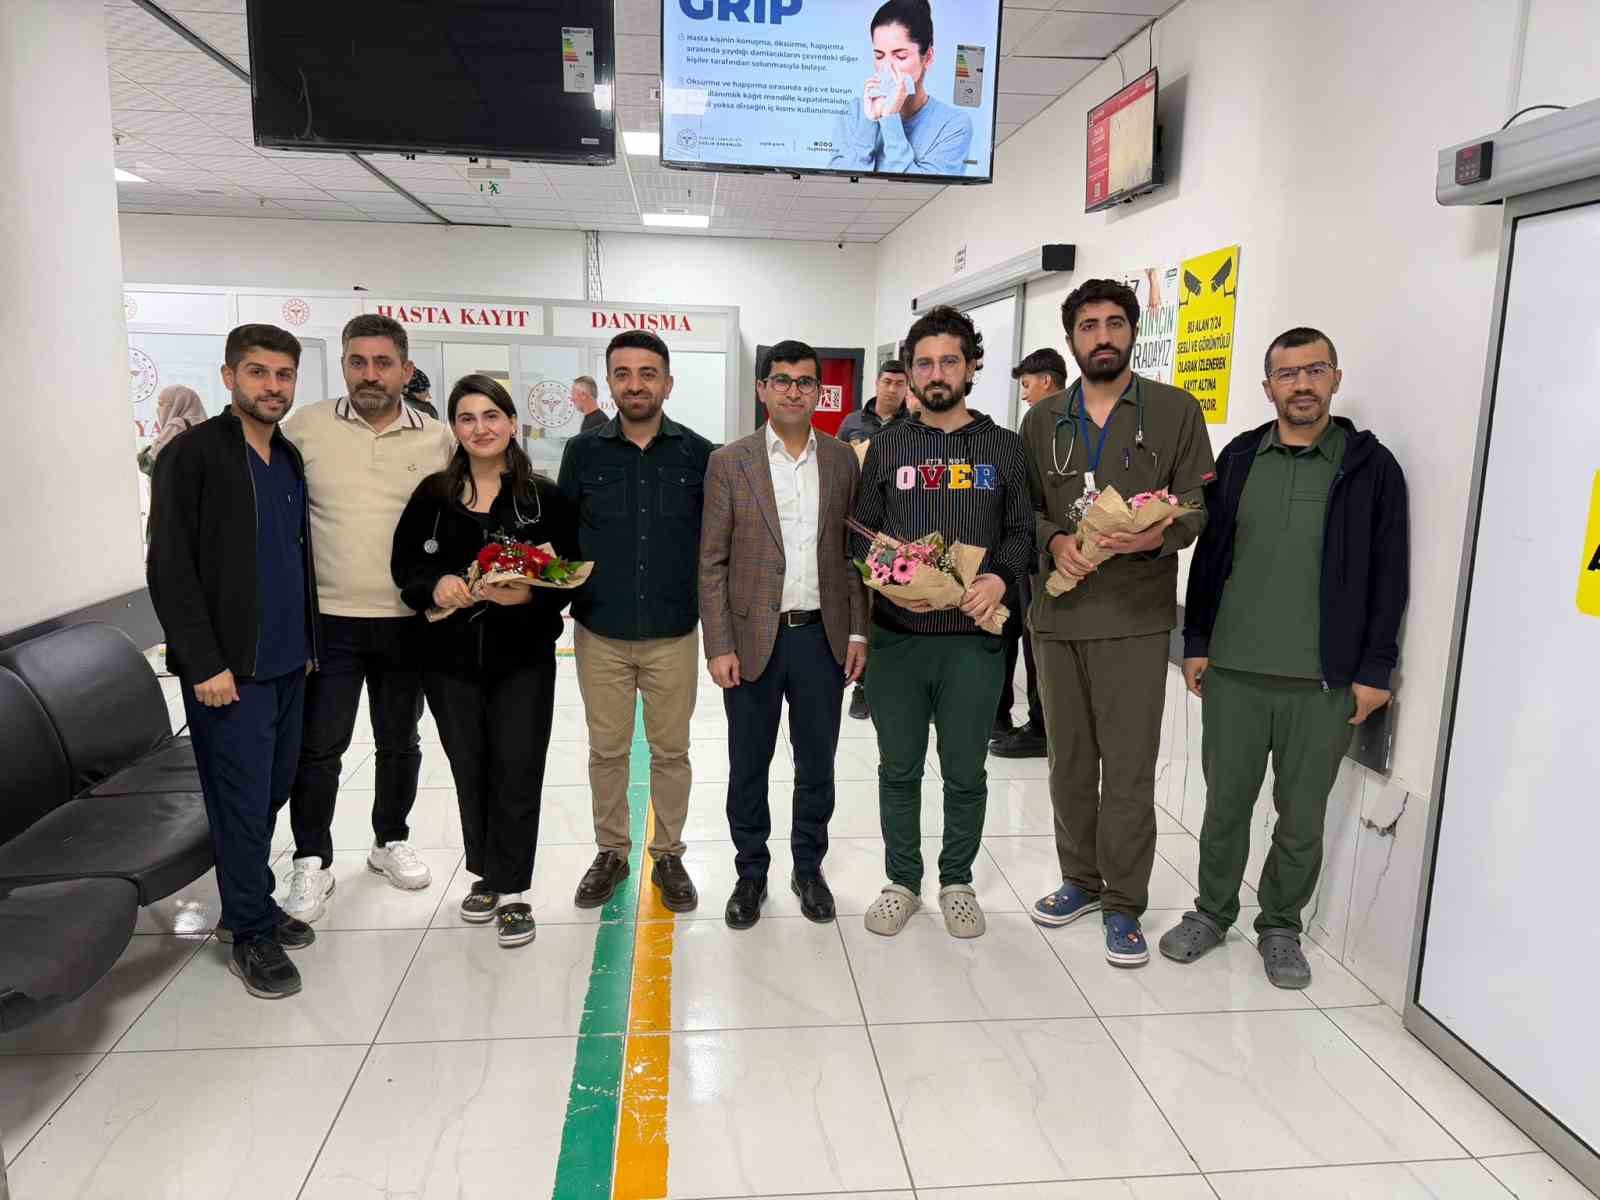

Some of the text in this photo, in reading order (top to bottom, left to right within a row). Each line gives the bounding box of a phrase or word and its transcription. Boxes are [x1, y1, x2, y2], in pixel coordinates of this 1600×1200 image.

[377, 304, 529, 327] HASTA KAYIT
[1195, 317, 1209, 333] ALAN
[1133, 340, 1171, 369] RADAYIZ
[896, 463, 998, 490] OVER
